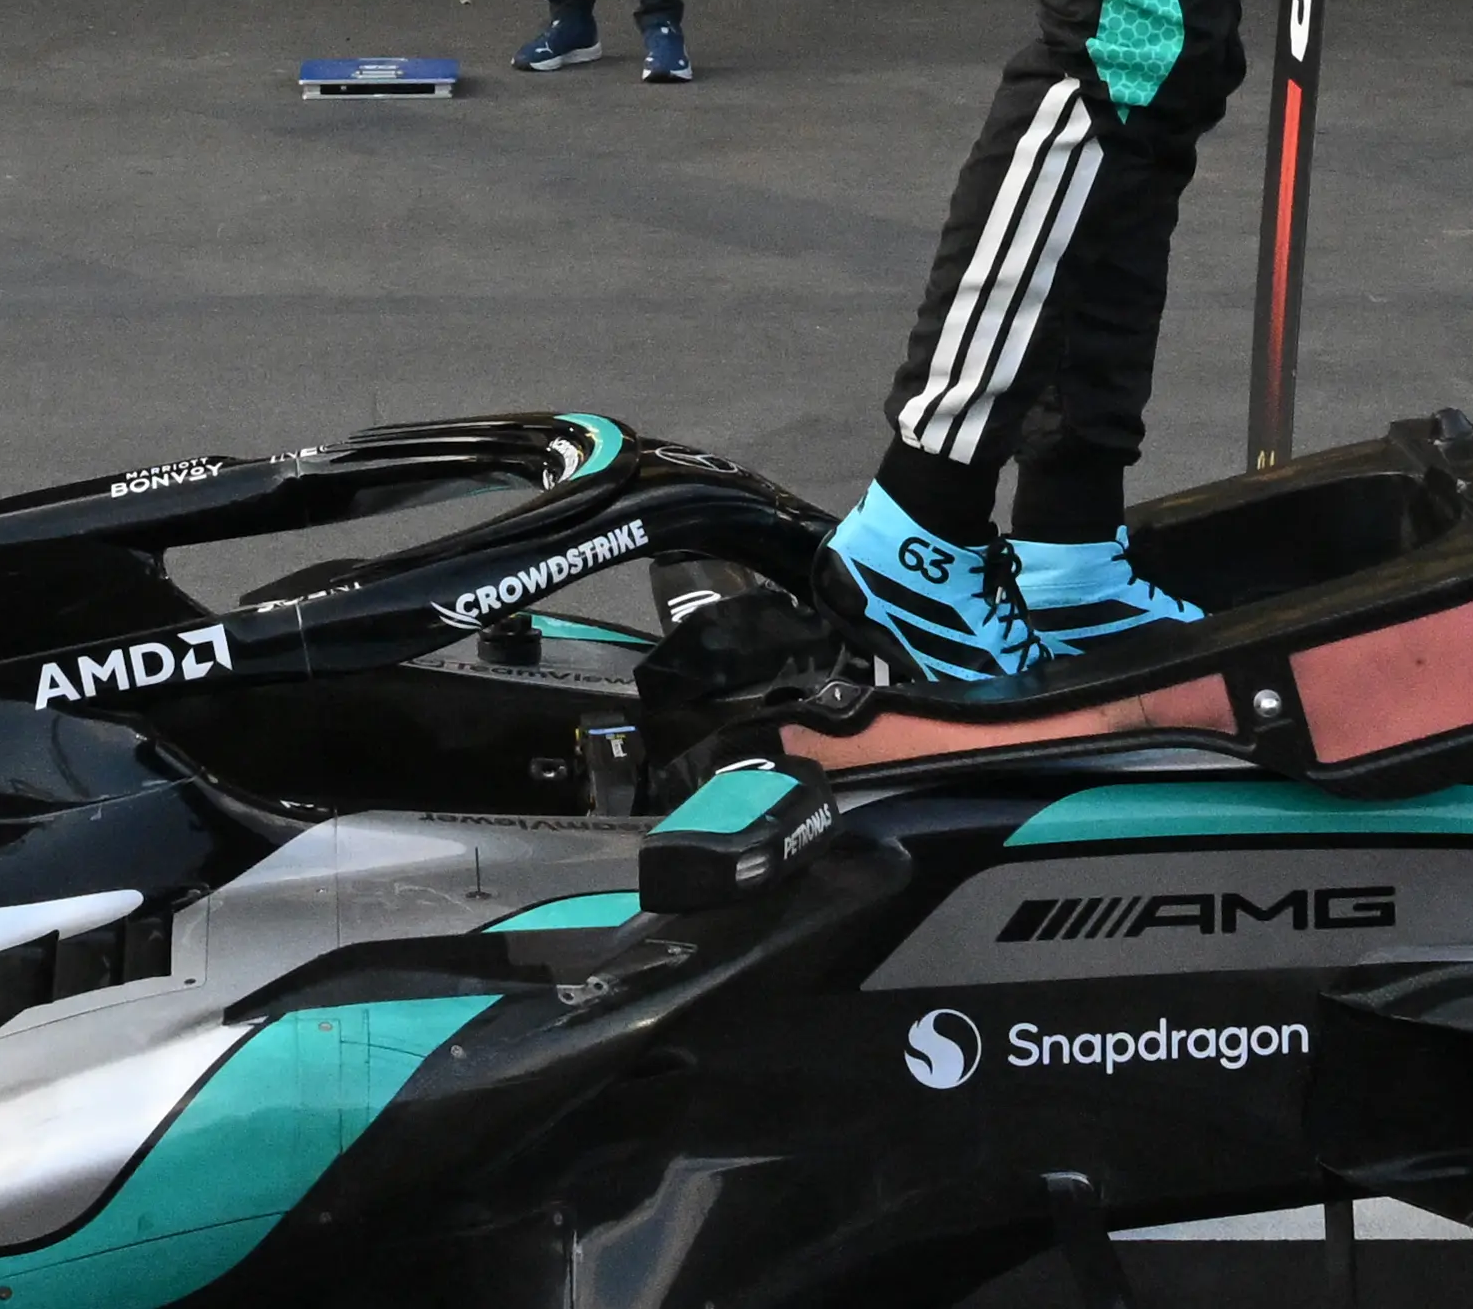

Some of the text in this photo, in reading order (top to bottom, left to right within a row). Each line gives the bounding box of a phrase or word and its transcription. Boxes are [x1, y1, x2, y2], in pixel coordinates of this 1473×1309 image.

[111, 462, 223, 497] BONVOY
[126, 457, 209, 480] MARRIOTT
[455, 519, 649, 619] CROWDSTRIKE
[898, 536, 955, 585] 63
[35, 644, 175, 710] AMD
[783, 803, 832, 859] PETRONAS
[1137, 886, 1396, 933] AMG
[1008, 1017, 1310, 1075] Snapdragon
